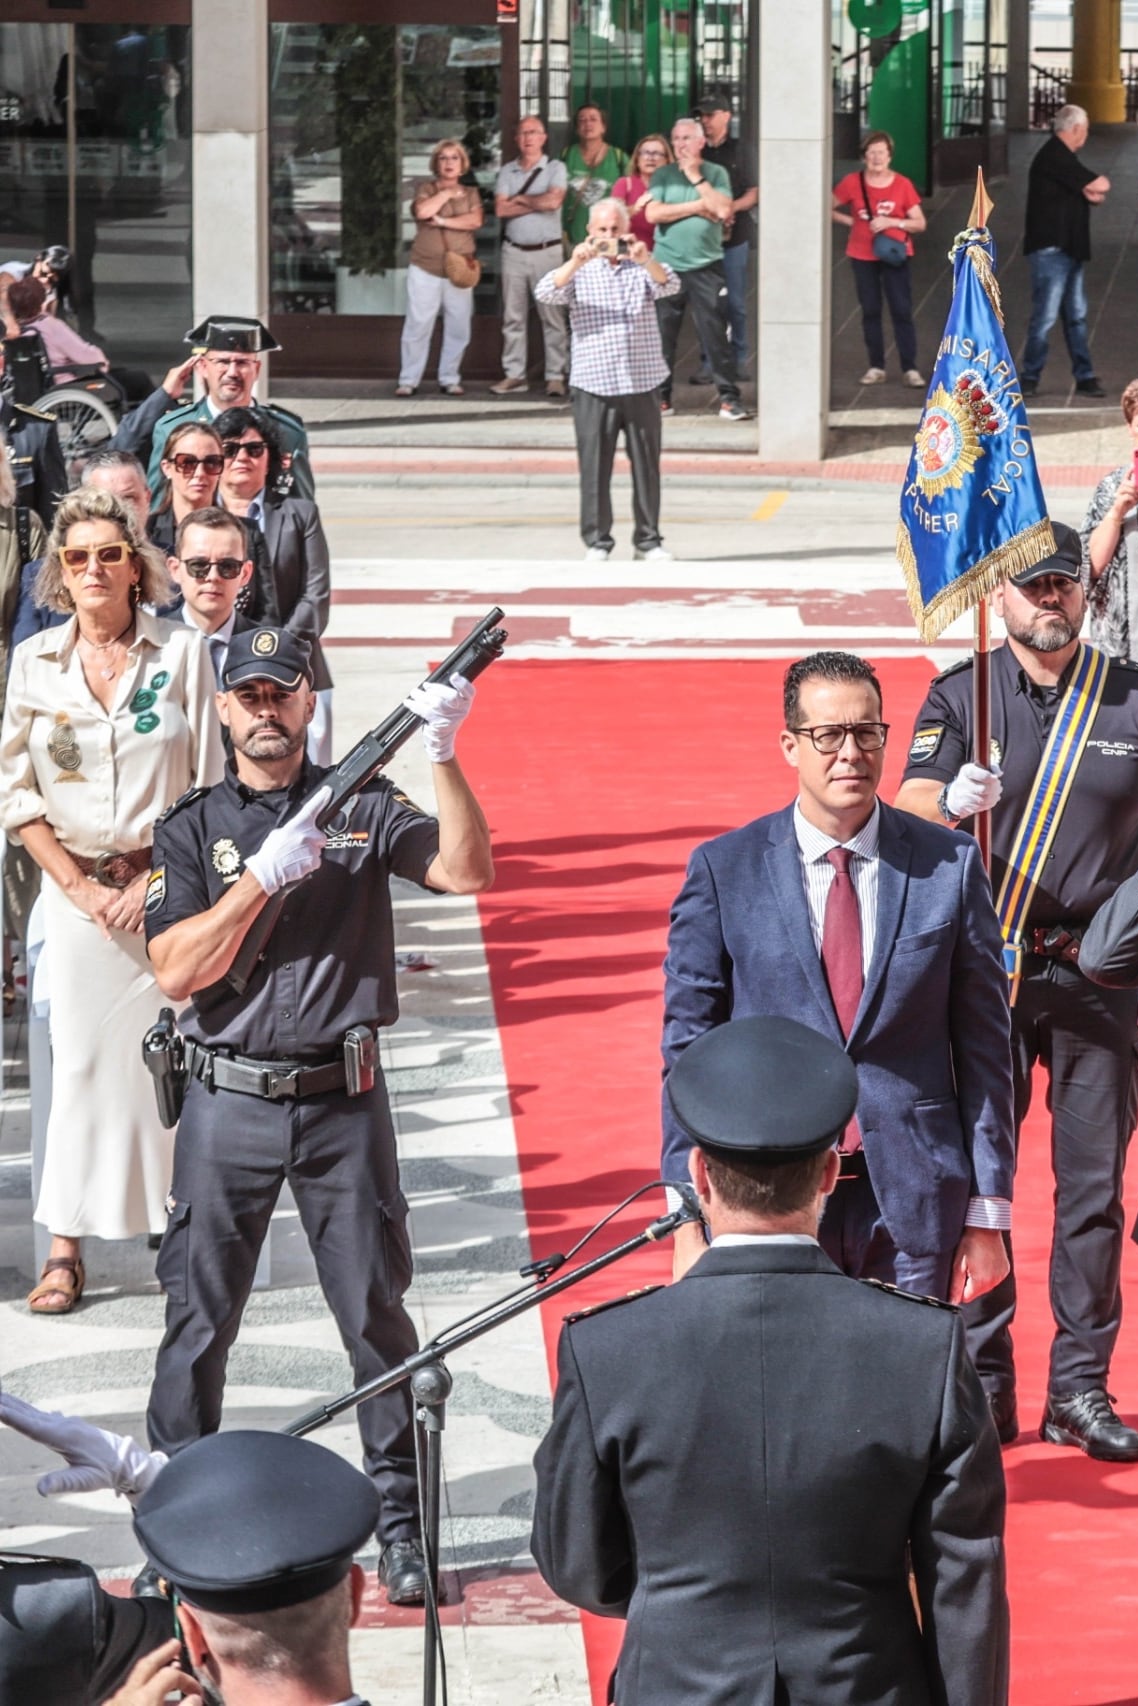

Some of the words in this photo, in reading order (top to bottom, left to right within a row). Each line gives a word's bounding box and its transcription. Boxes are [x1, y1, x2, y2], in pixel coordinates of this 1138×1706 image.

[982, 425, 1031, 506] LOCAL
[1086, 740, 1135, 751] POLICIA
[1101, 748, 1128, 756] CNP
